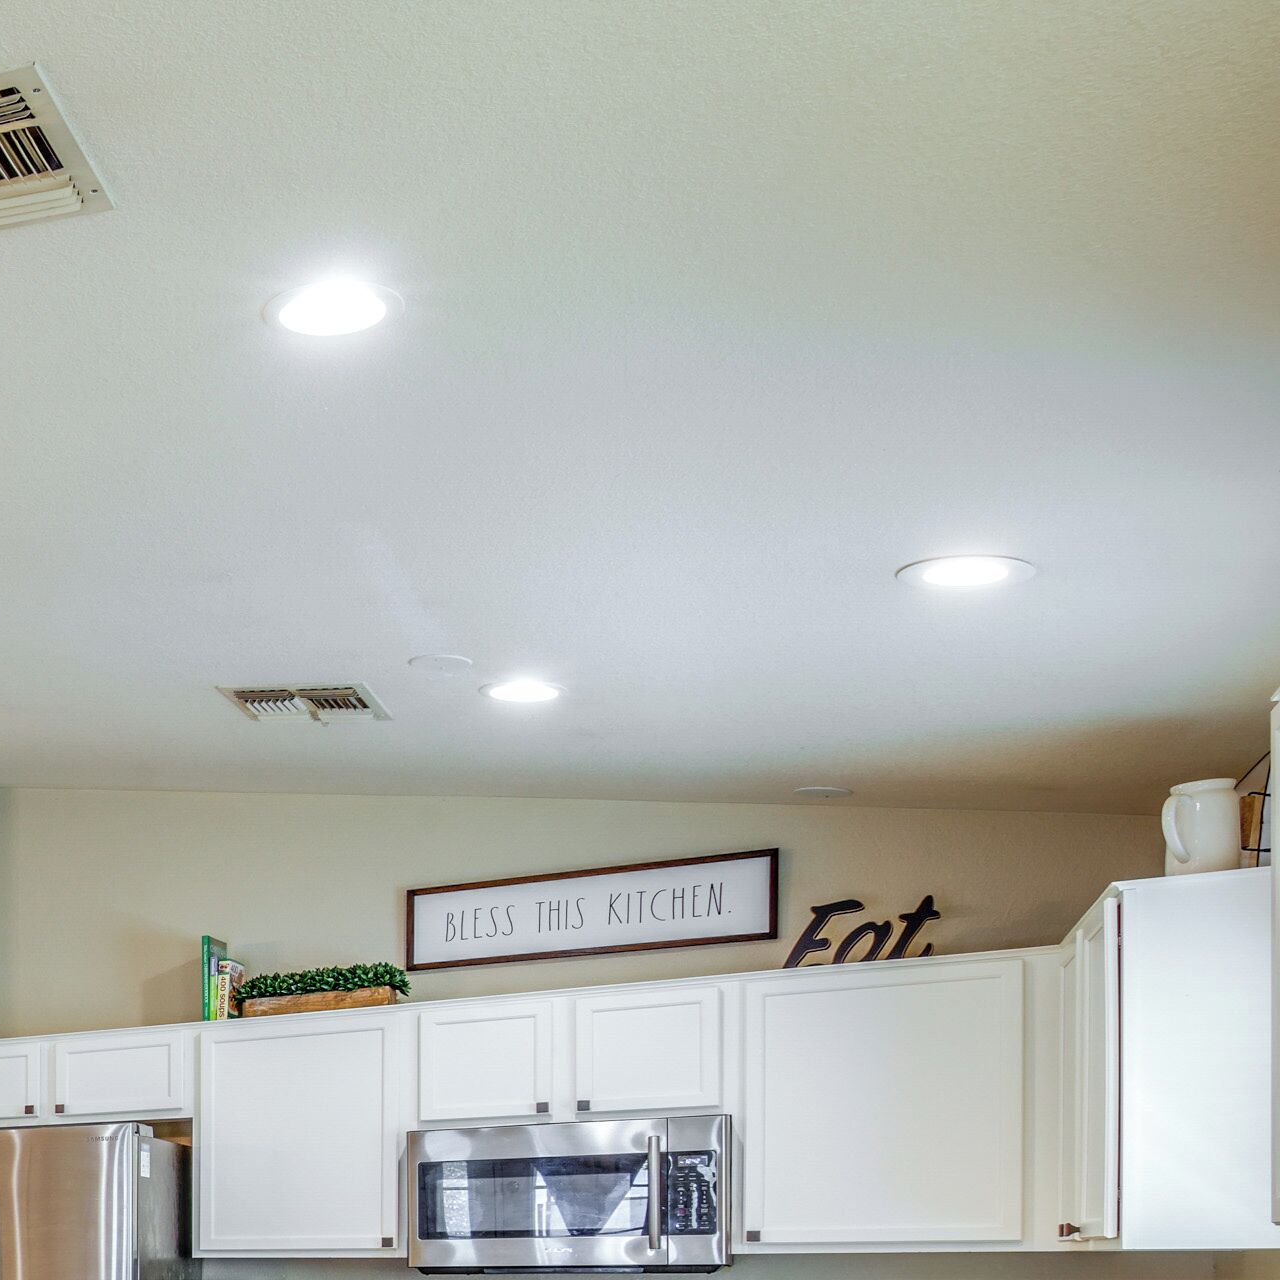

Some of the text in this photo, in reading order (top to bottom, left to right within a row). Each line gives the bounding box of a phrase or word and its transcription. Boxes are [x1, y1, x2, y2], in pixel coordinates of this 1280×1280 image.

[445, 882, 733, 942] BLESS THIS KITCHEN.
[783, 894, 941, 969] Eat
[86, 1135, 119, 1143] SAMSUNG
